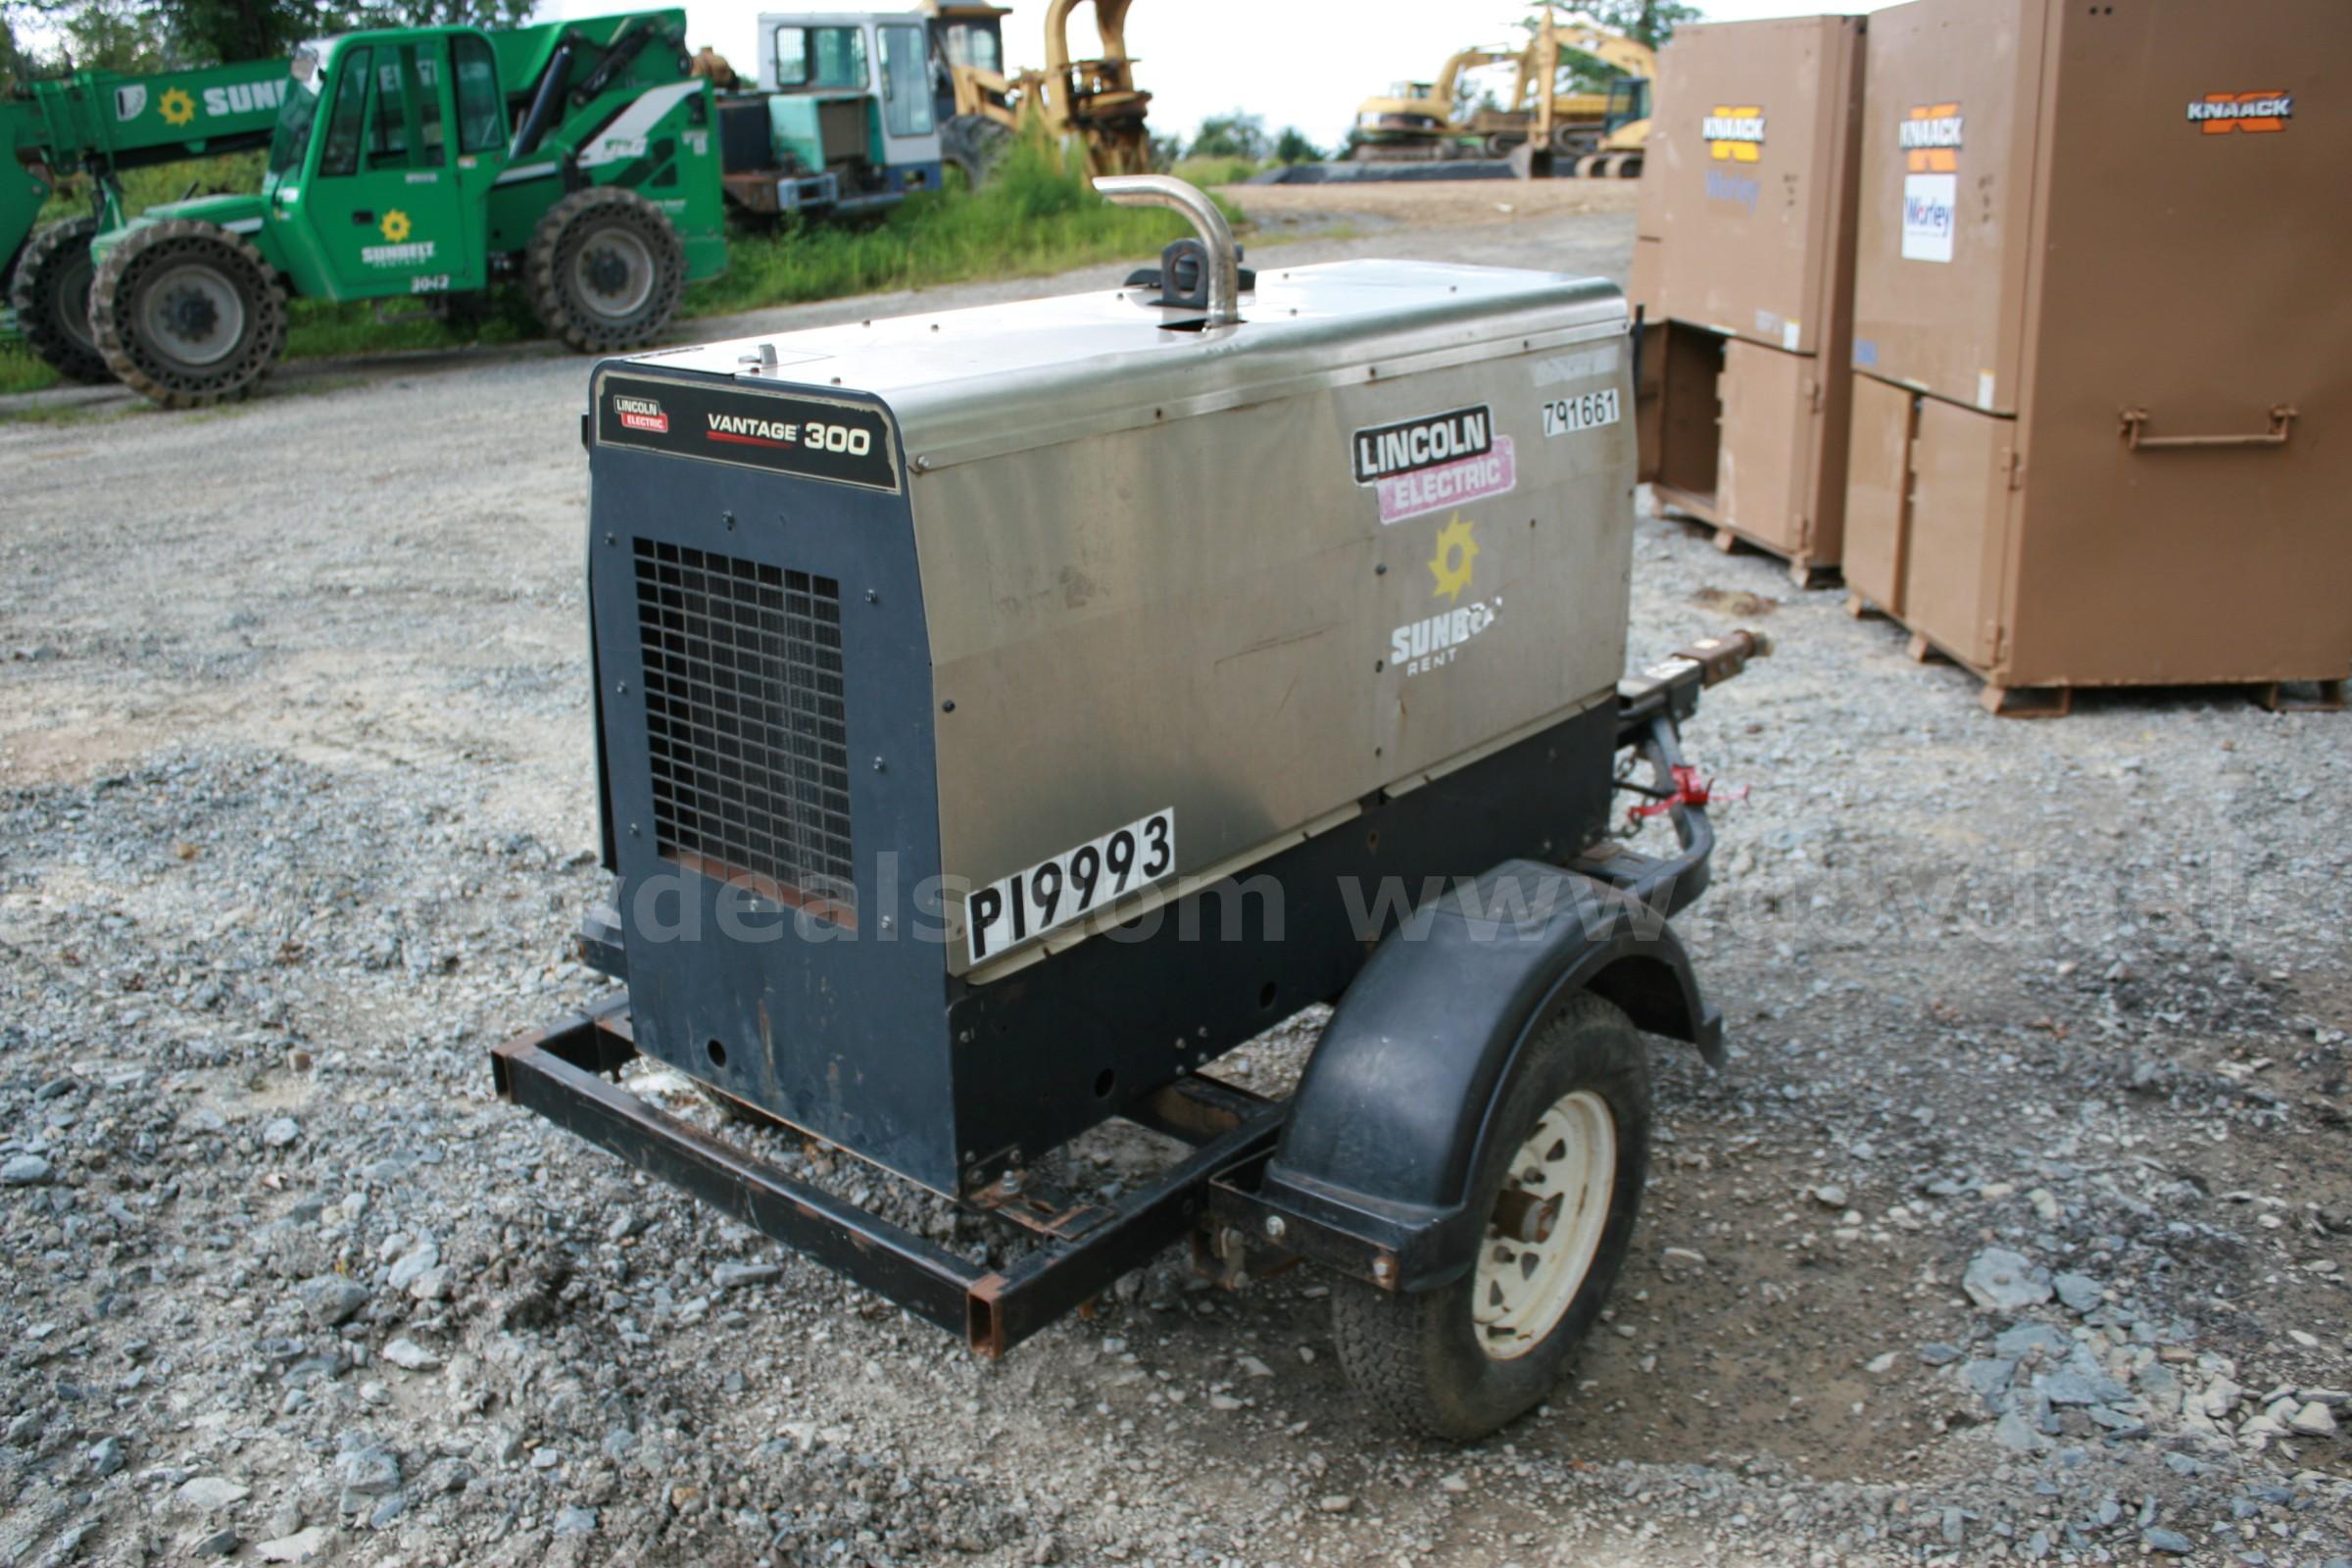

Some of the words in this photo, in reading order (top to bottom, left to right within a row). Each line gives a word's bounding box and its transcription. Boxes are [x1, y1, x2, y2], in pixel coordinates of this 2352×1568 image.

[2186, 97, 2291, 121] KNAACK
[615, 399, 658, 416] LINCOLN
[626, 415, 663, 429] ELECTRIC
[1544, 391, 1616, 434] 791661
[708, 414, 797, 441] VANTAGE
[804, 421, 870, 456] 300
[1359, 413, 1487, 475] LINCOLN
[1394, 457, 1502, 510] ELECTRIC
